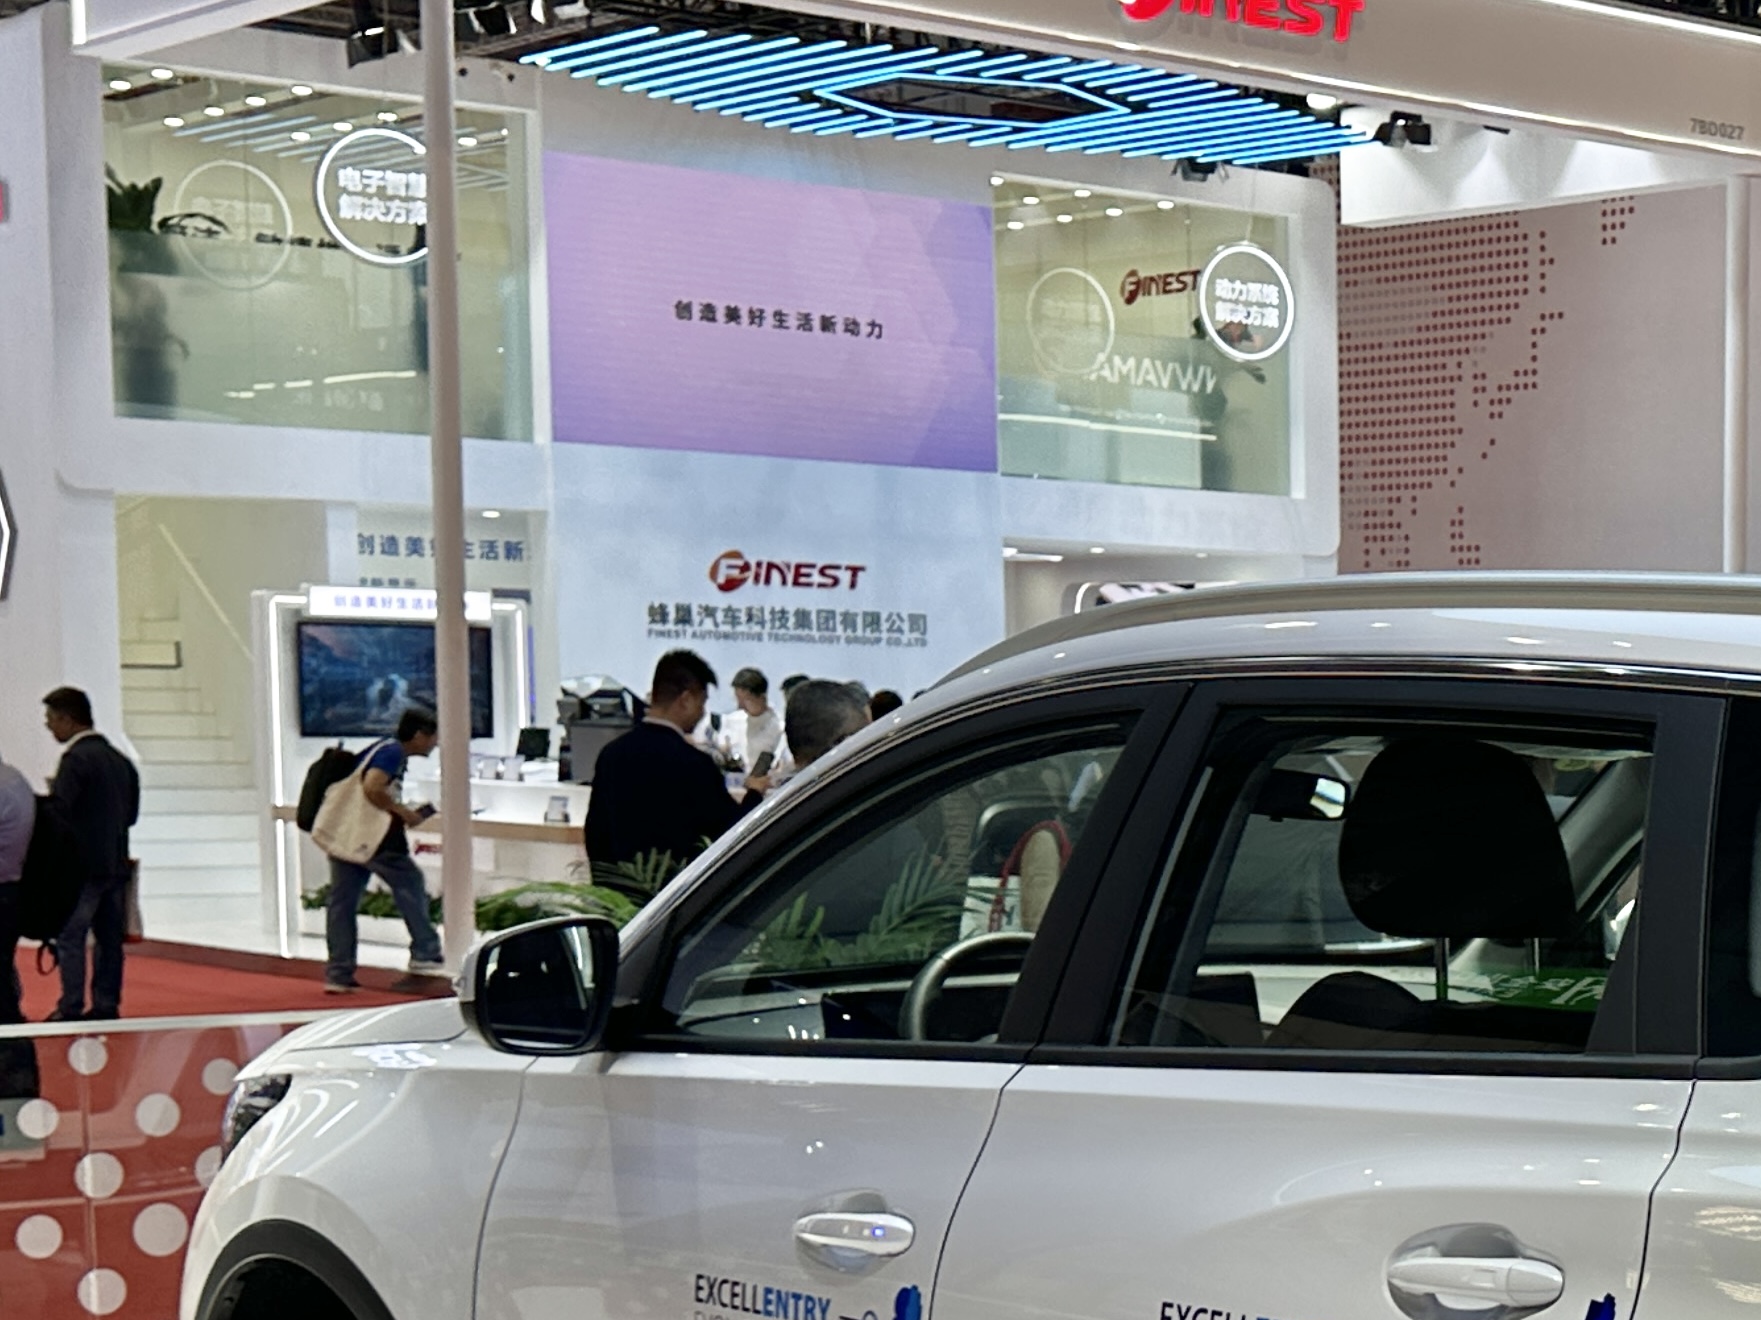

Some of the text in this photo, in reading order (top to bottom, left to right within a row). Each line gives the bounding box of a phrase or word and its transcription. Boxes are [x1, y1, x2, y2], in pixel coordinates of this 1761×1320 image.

[1120, 269, 1201, 306] FINEST
[674, 300, 884, 340] 创造美好生活新动力
[709, 549, 867, 593] FINEST
[648, 602, 928, 636] 蜂巢汽车科技集团有限公司
[648, 629, 687, 640] FINEST
[691, 631, 763, 643] AUTOMOTIVE
[767, 633, 842, 645] TECHNOLOGY
